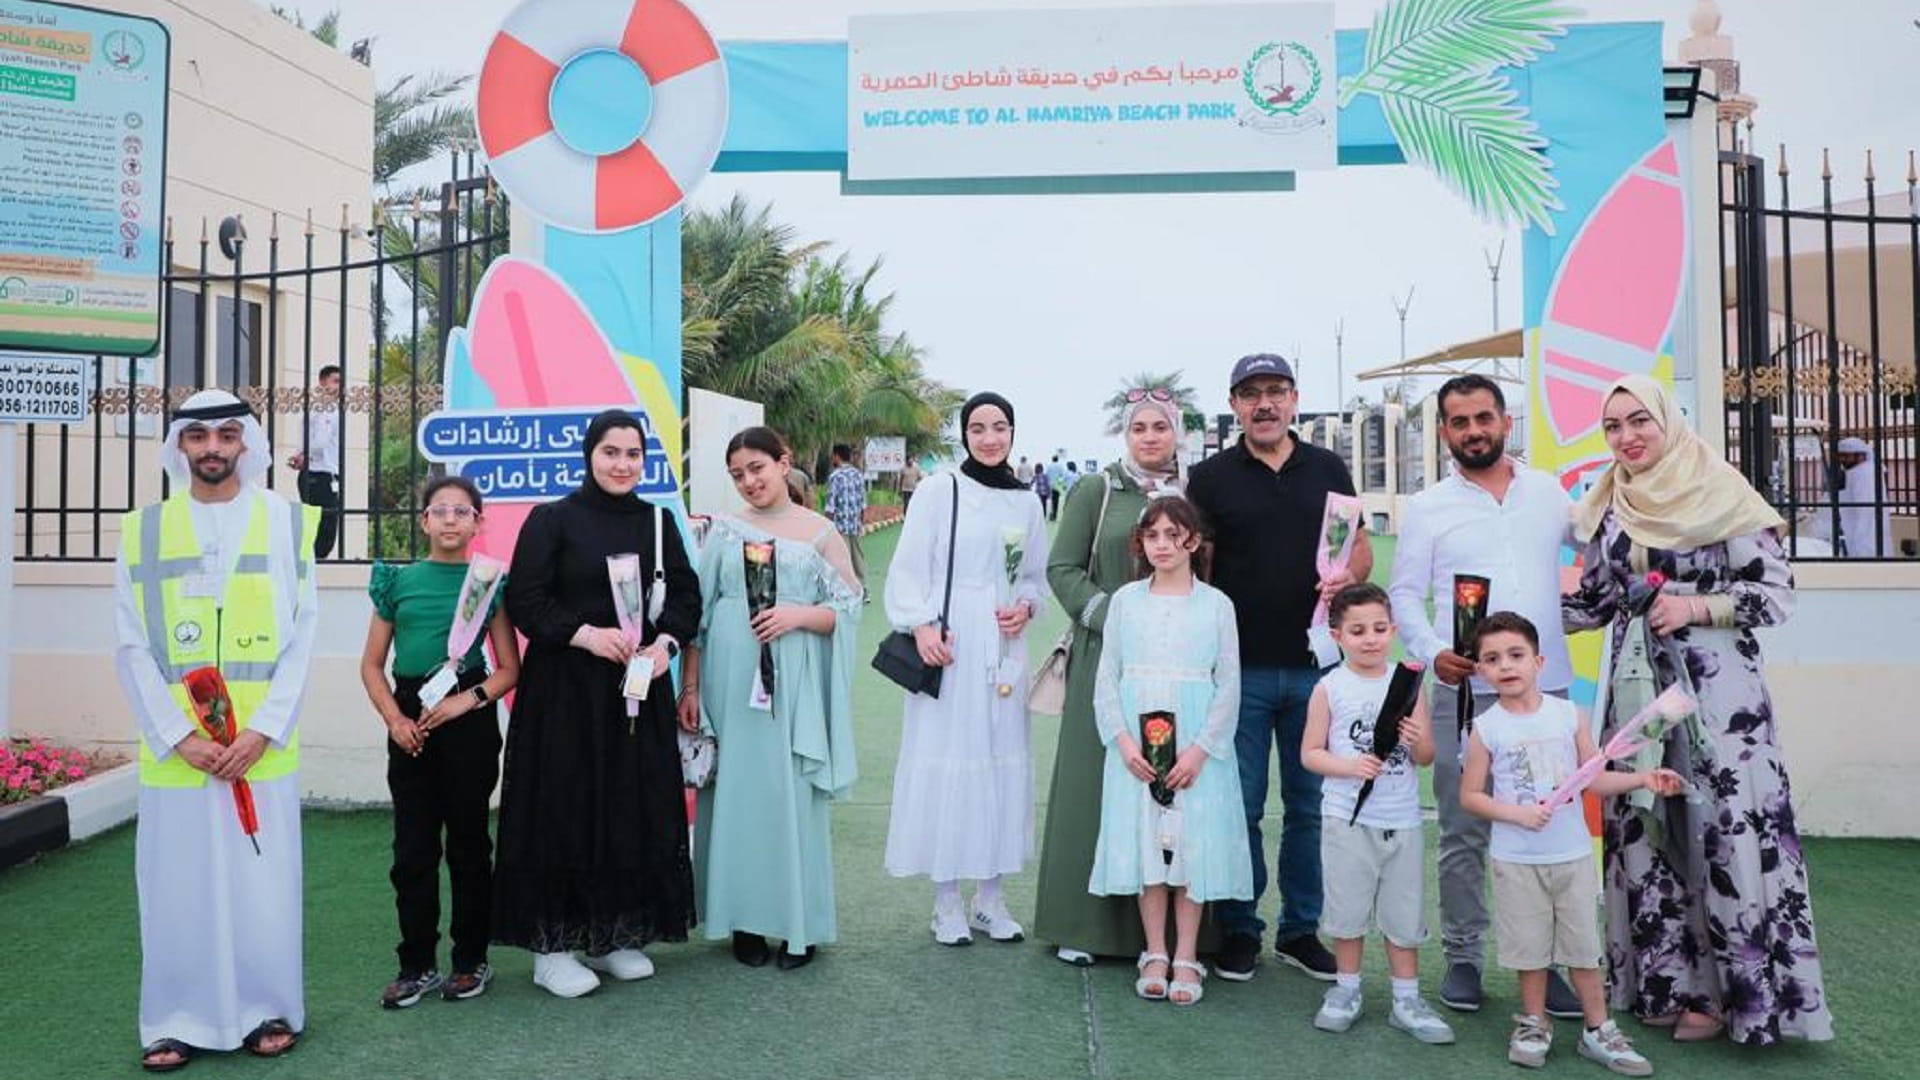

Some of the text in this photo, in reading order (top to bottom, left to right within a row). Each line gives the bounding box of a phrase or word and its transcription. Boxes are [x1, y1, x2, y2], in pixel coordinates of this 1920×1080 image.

[861, 71, 938, 94] الحمرية
[942, 65, 1012, 91] شاطئ
[1017, 65, 1078, 89] حديقة
[1083, 64, 1119, 91] في
[1124, 65, 1173, 87] بكم
[863, 102, 1237, 128] WELCOME TO AL HAMRIYA BEACH PARK
[433, 416, 541, 449] إرشادات
[474, 457, 548, 494] بأمان
